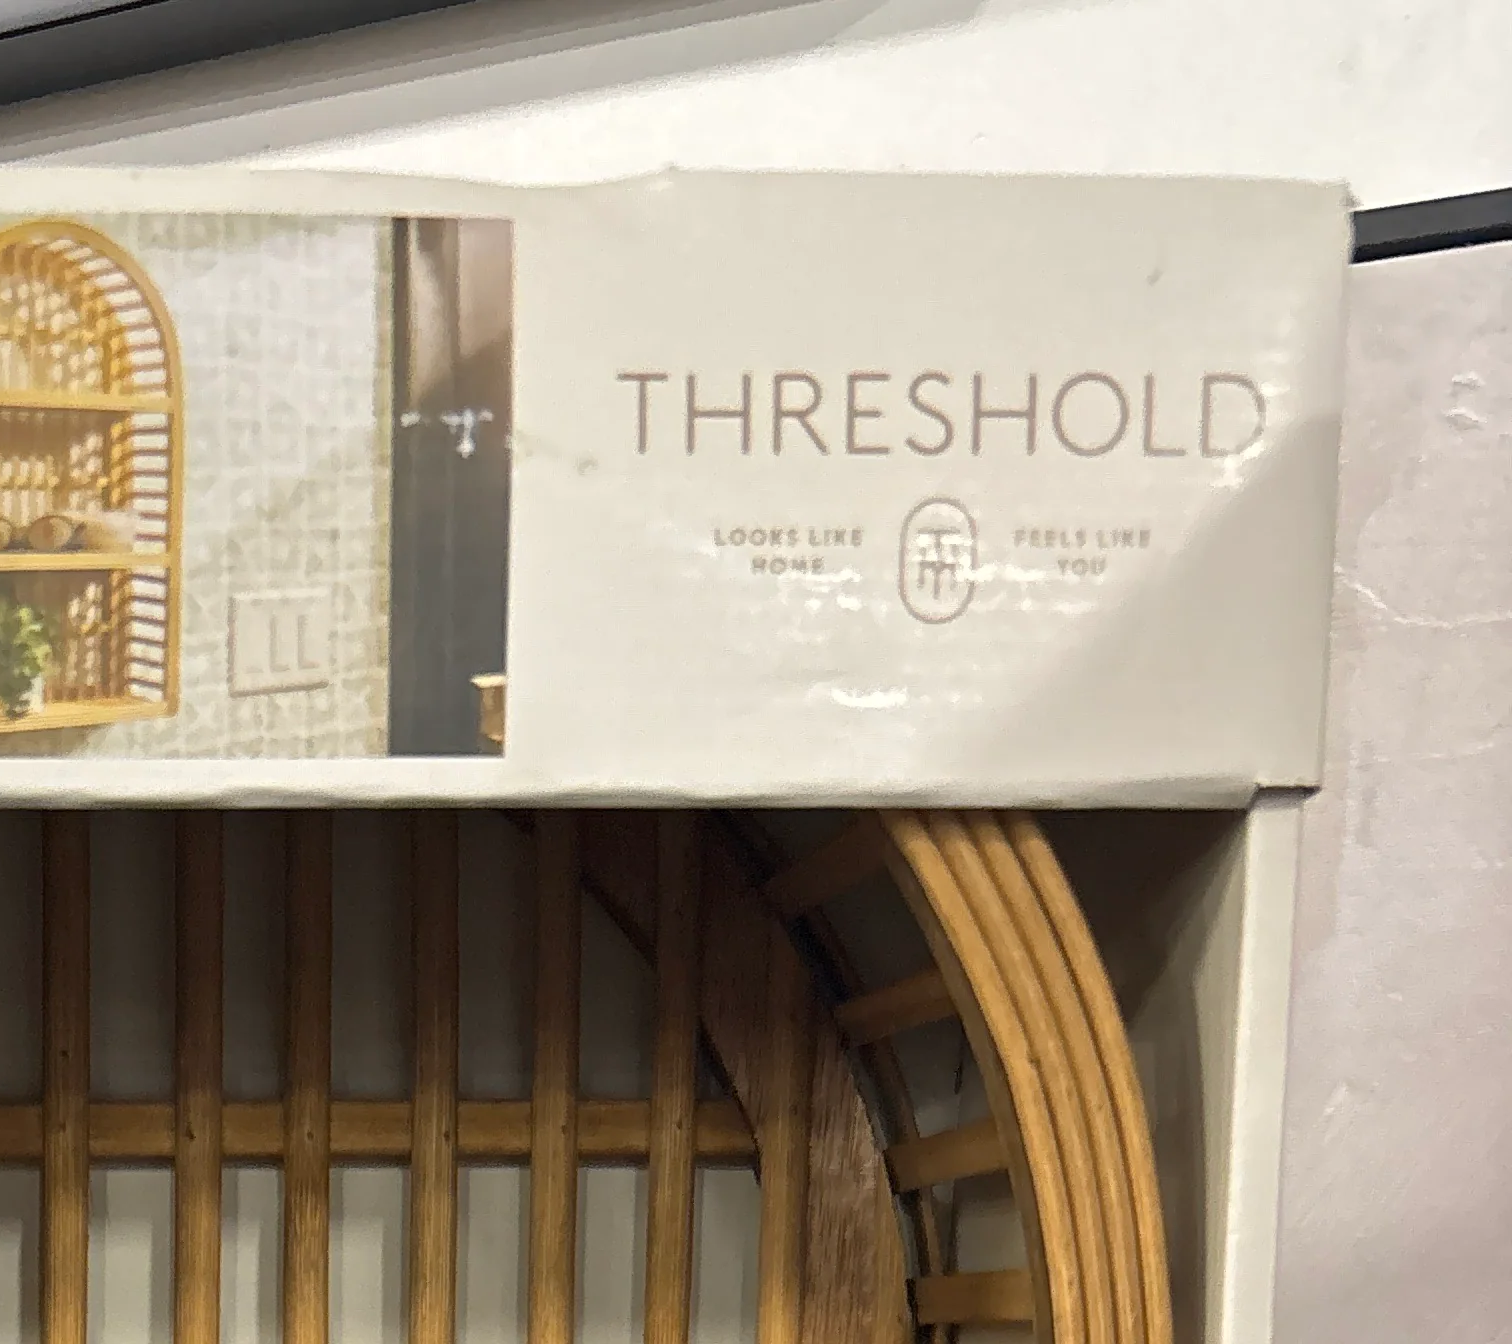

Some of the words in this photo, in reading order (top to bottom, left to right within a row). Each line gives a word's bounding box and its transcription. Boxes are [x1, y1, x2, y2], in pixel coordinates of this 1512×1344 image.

[616, 370, 1265, 457] THRESHOLD
[714, 527, 798, 546] LOOKS
[809, 527, 863, 547] LIKE
[1014, 527, 1086, 548] FEELS
[1096, 529, 1150, 548] LIKE
[752, 556, 824, 575] HOME
[1057, 557, 1106, 576] YOU
